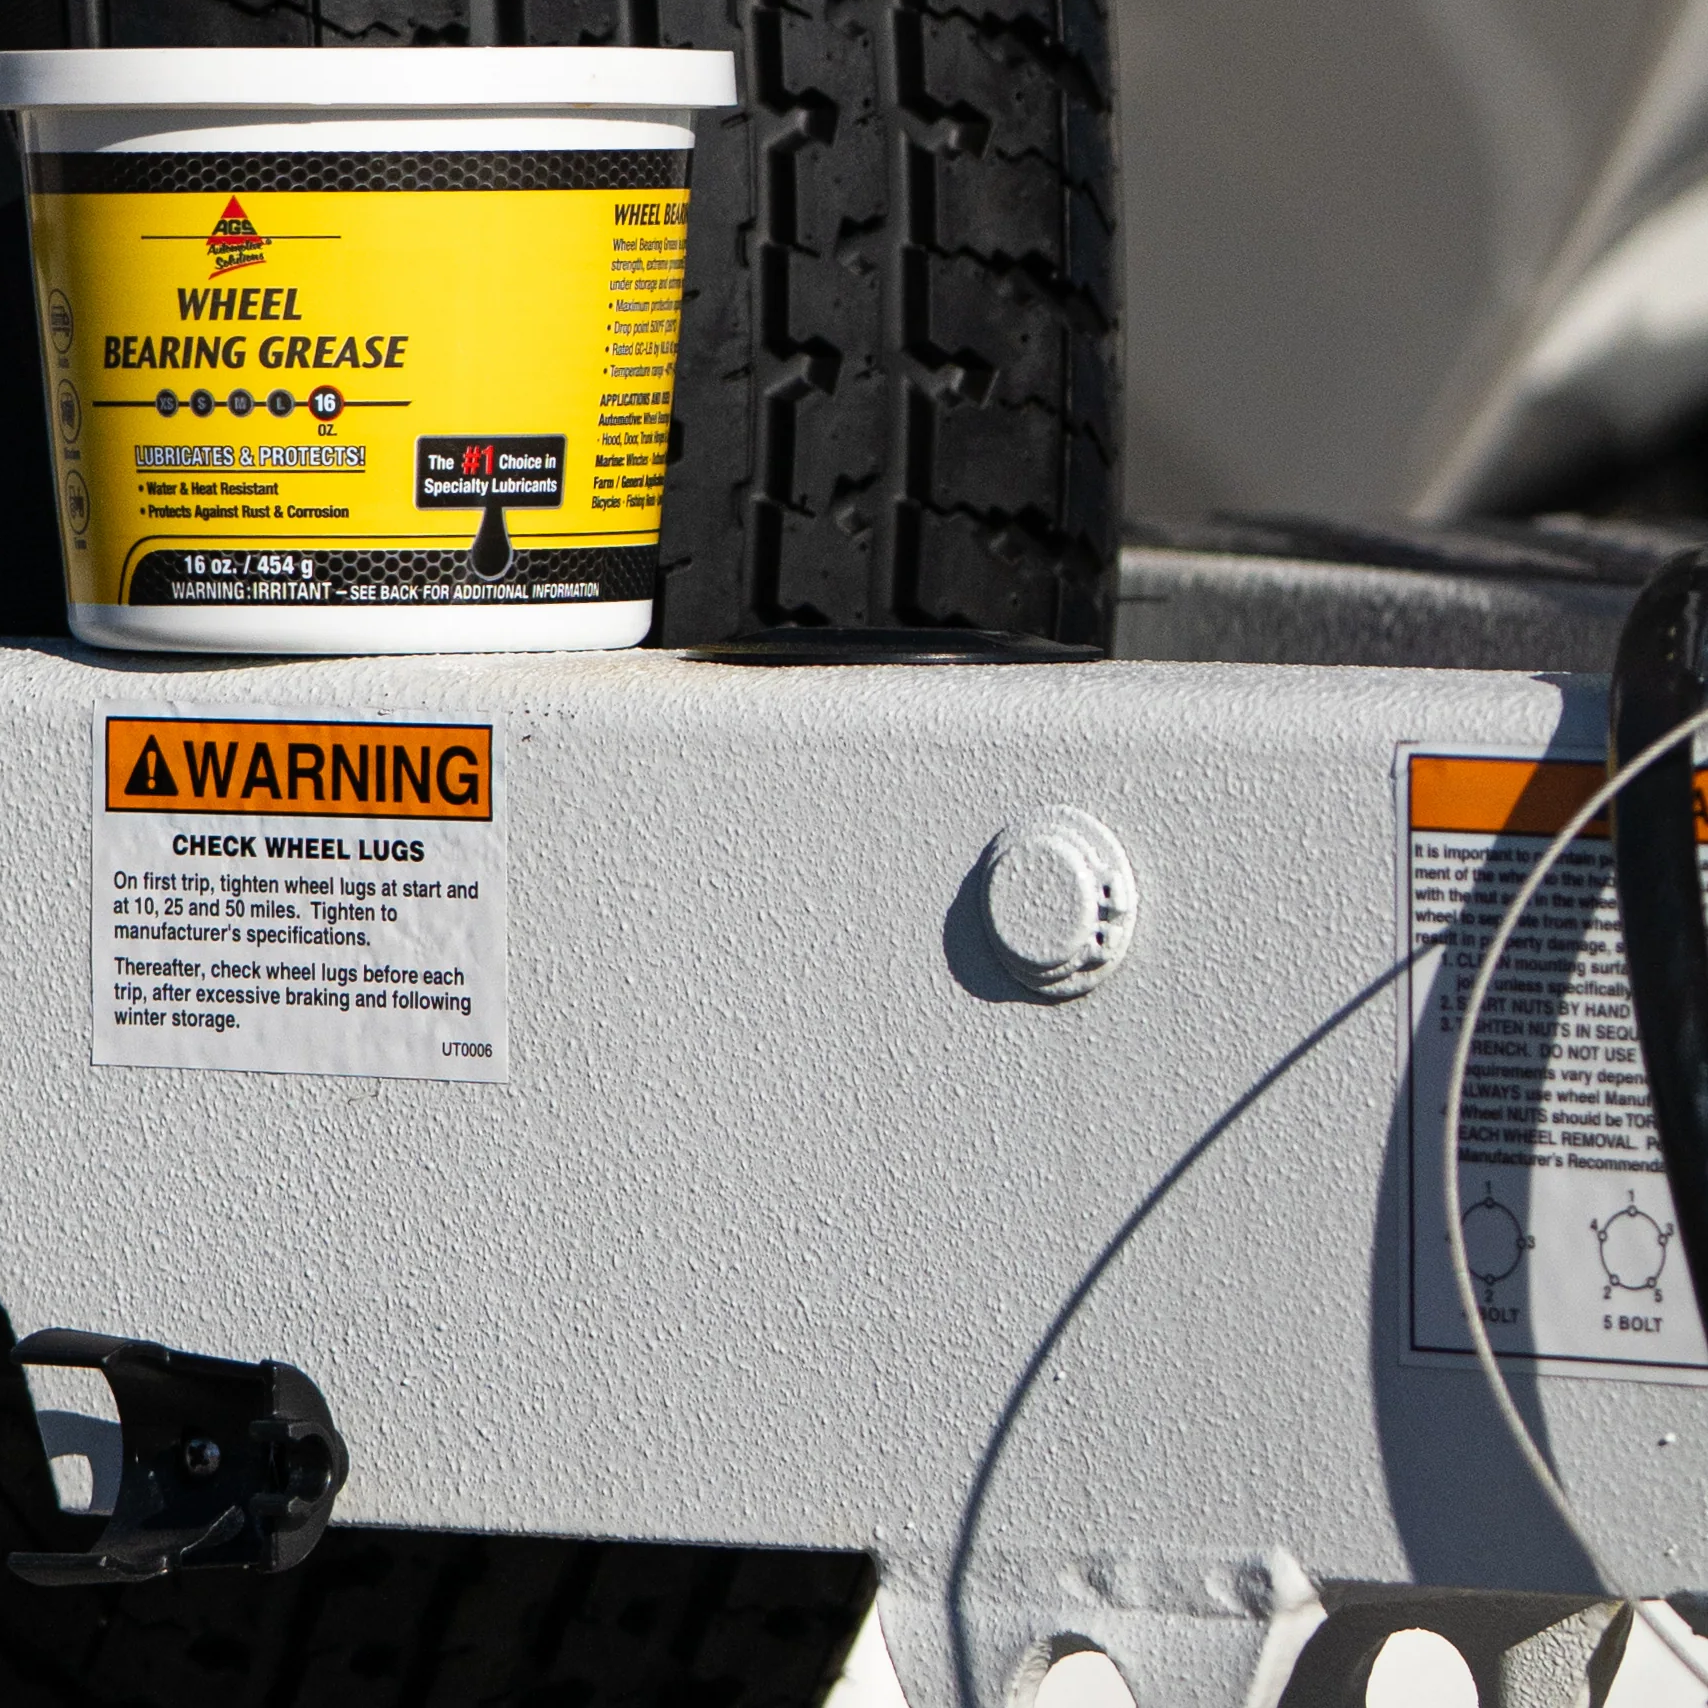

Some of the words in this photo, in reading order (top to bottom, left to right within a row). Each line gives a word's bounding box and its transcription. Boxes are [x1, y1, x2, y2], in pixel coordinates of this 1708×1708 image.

[614, 204, 660, 225] WHEEL
[212, 219, 258, 235] AGS
[613, 238, 637, 251] Wheel
[215, 252, 264, 269] Solutions
[611, 258, 644, 273] strength,
[610, 278, 633, 290] under
[178, 288, 302, 320] WHEEL
[616, 300, 649, 312] Maximum
[614, 321, 632, 336] Drop
[104, 336, 246, 369] BEARING
[258, 336, 409, 369] GREASE
[613, 342, 633, 355] Rated
[315, 394, 336, 411] 16
[600, 393, 650, 407] APPLICATIONS
[318, 424, 337, 436] OZ.
[602, 433, 622, 447] Hood,
[135, 446, 234, 467] LUBRICATES
[239, 446, 255, 467] &
[259, 446, 365, 467] PROTECTS!
[428, 455, 454, 470] The
[462, 445, 495, 475] #1
[499, 455, 541, 470] Choice
[545, 454, 556, 469] in
[147, 482, 177, 495] Water
[180, 482, 188, 495] &
[192, 482, 217, 495] Heat
[221, 482, 278, 495] Resistant
[425, 478, 488, 496] Specialty
[492, 478, 557, 493] Lubricants
[594, 476, 614, 489] Farm
[591, 495, 621, 511] Bicycles
[148, 505, 191, 518] Protects
[195, 505, 238, 521] Against
[242, 506, 270, 518] Rust
[274, 506, 283, 518] &
[287, 506, 349, 518] Corrosion
[184, 555, 205, 574] 16
[211, 558, 237, 574] oz.
[243, 555, 251, 574] /
[257, 555, 293, 574] 454
[301, 559, 313, 579] g
[350, 586, 376, 600] SEE
[381, 586, 418, 600] BACK
[423, 585, 450, 599] FOR
[454, 584, 528, 599] ADDITIONAL
[533, 583, 599, 598] INFORMATION
[184, 741, 479, 805] WARNING
[173, 835, 256, 857] CHECK
[266, 837, 350, 860] WHEEL
[359, 839, 424, 862] LUGS
[1416, 845, 1423, 857] It
[1427, 845, 1439, 858] is
[1444, 846, 1512, 862] important
[1516, 849, 1529, 861] to
[114, 872, 138, 889] On
[143, 872, 177, 890] first
[181, 873, 215, 895] trip,
[220, 875, 279, 898] tighten
[285, 877, 333, 895] wheel
[340, 877, 376, 899] lugs
[381, 881, 398, 897] at
[403, 881, 441, 898] start
[447, 881, 478, 899] and
[1416, 867, 1450, 880] ment
[1455, 868, 1468, 880] of
[1473, 869, 1494, 882] the
[1562, 872, 1583, 886] the
[1416, 888, 1444, 901] with
[1449, 889, 1471, 902] the
[1475, 891, 1497, 903] nut
[1536, 894, 1548, 906] in
[1553, 894, 1573, 906] the
[113, 900, 129, 915] at
[135, 898, 159, 919] 10,
[164, 899, 184, 916] 25
[189, 900, 220, 917] and
[226, 901, 245, 918] 50
[250, 901, 301, 919] miles.
[311, 902, 375, 924] Tighten
[381, 905, 398, 922] to
[1416, 910, 1456, 922] wheel
[1461, 911, 1475, 924] to
[1543, 916, 1578, 929] from
[114, 924, 241, 942] manufacturer's
[247, 927, 371, 947] specifications.
[1416, 931, 1457, 944] result
[1462, 933, 1473, 945] in
[1547, 938, 1611, 955] damage,
[114, 957, 206, 980] Thereafter,
[211, 960, 261, 979] check
[266, 962, 316, 981] wheel
[322, 964, 358, 984] lugs
[363, 965, 418, 984] before
[423, 967, 464, 985] each
[1515, 957, 1585, 975] mounting
[1495, 978, 1542, 991] unless
[1549, 980, 1631, 1000] specifically
[114, 983, 147, 1004] trip,
[152, 984, 190, 1002] after
[196, 988, 280, 1005] excessive
[286, 988, 349, 1011] braking
[356, 990, 386, 1008] and
[392, 991, 472, 1015] following
[1513, 998, 1554, 1015] NUTS
[1559, 1001, 1579, 1016] BY
[1585, 1003, 1630, 1019] HAND
[114, 1009, 167, 1027] winter
[172, 1011, 240, 1032] storage.
[1529, 1020, 1571, 1038] NUTS
[1576, 1024, 1590, 1039] IN
[442, 1042, 492, 1058] UT0006
[1540, 1043, 1563, 1058] DO
[1568, 1044, 1600, 1061] NOT
[1605, 1046, 1637, 1063] USE
[1561, 1069, 1592, 1085] vary
[1526, 1089, 1552, 1101] use
[1557, 1090, 1600, 1104] wheel
[1507, 1106, 1547, 1123] NUTS
[1552, 1111, 1600, 1126] should
[1605, 1112, 1622, 1127] be
[1459, 1125, 1499, 1142] EACH
[1504, 1127, 1555, 1145] WHEEL
[1562, 1131, 1638, 1150] REMOVAL.
[1603, 1287, 1612, 1300] 2
[1654, 1290, 1663, 1302] 5
[1604, 1315, 1613, 1330] 5
[1619, 1317, 1663, 1332] BOLT
